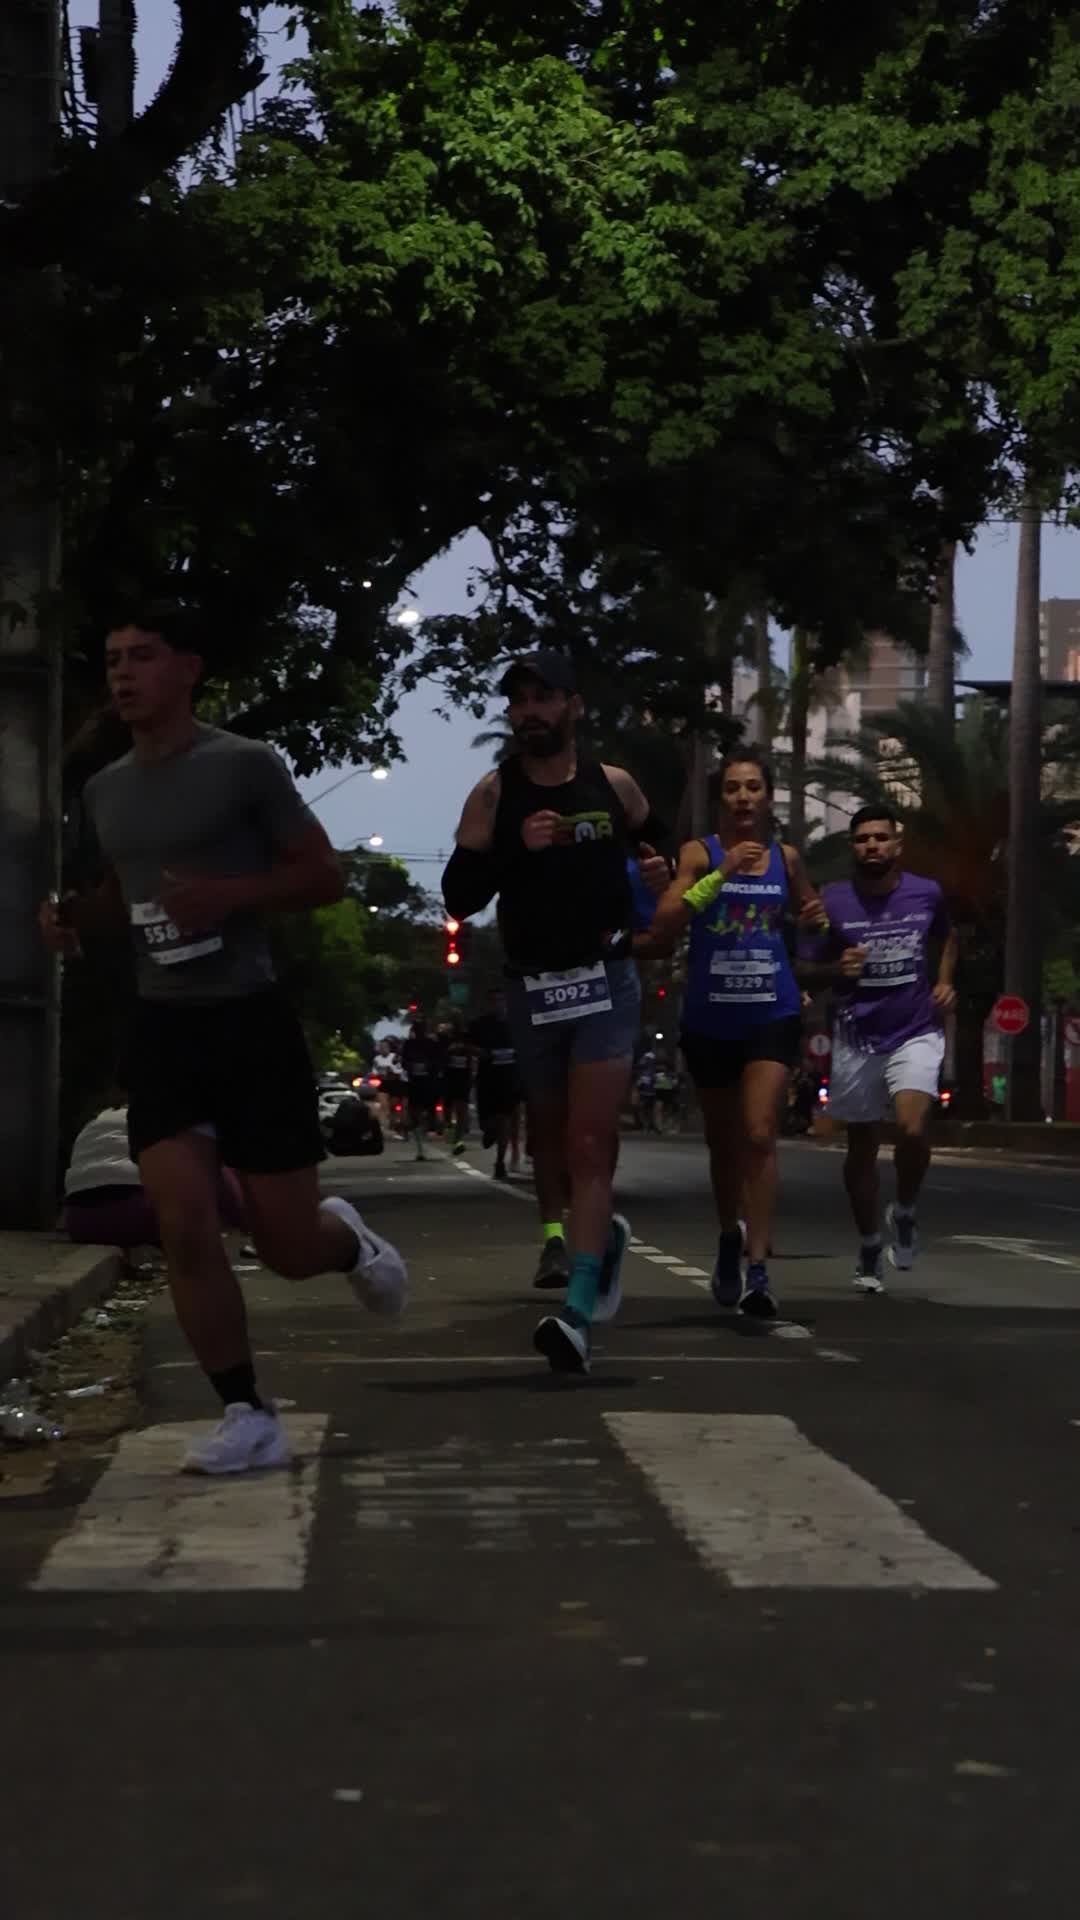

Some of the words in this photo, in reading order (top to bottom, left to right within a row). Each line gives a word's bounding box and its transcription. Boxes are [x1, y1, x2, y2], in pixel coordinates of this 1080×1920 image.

[143, 921, 181, 945] 558
[723, 976, 764, 989] 5329
[543, 983, 591, 1005] 5092
